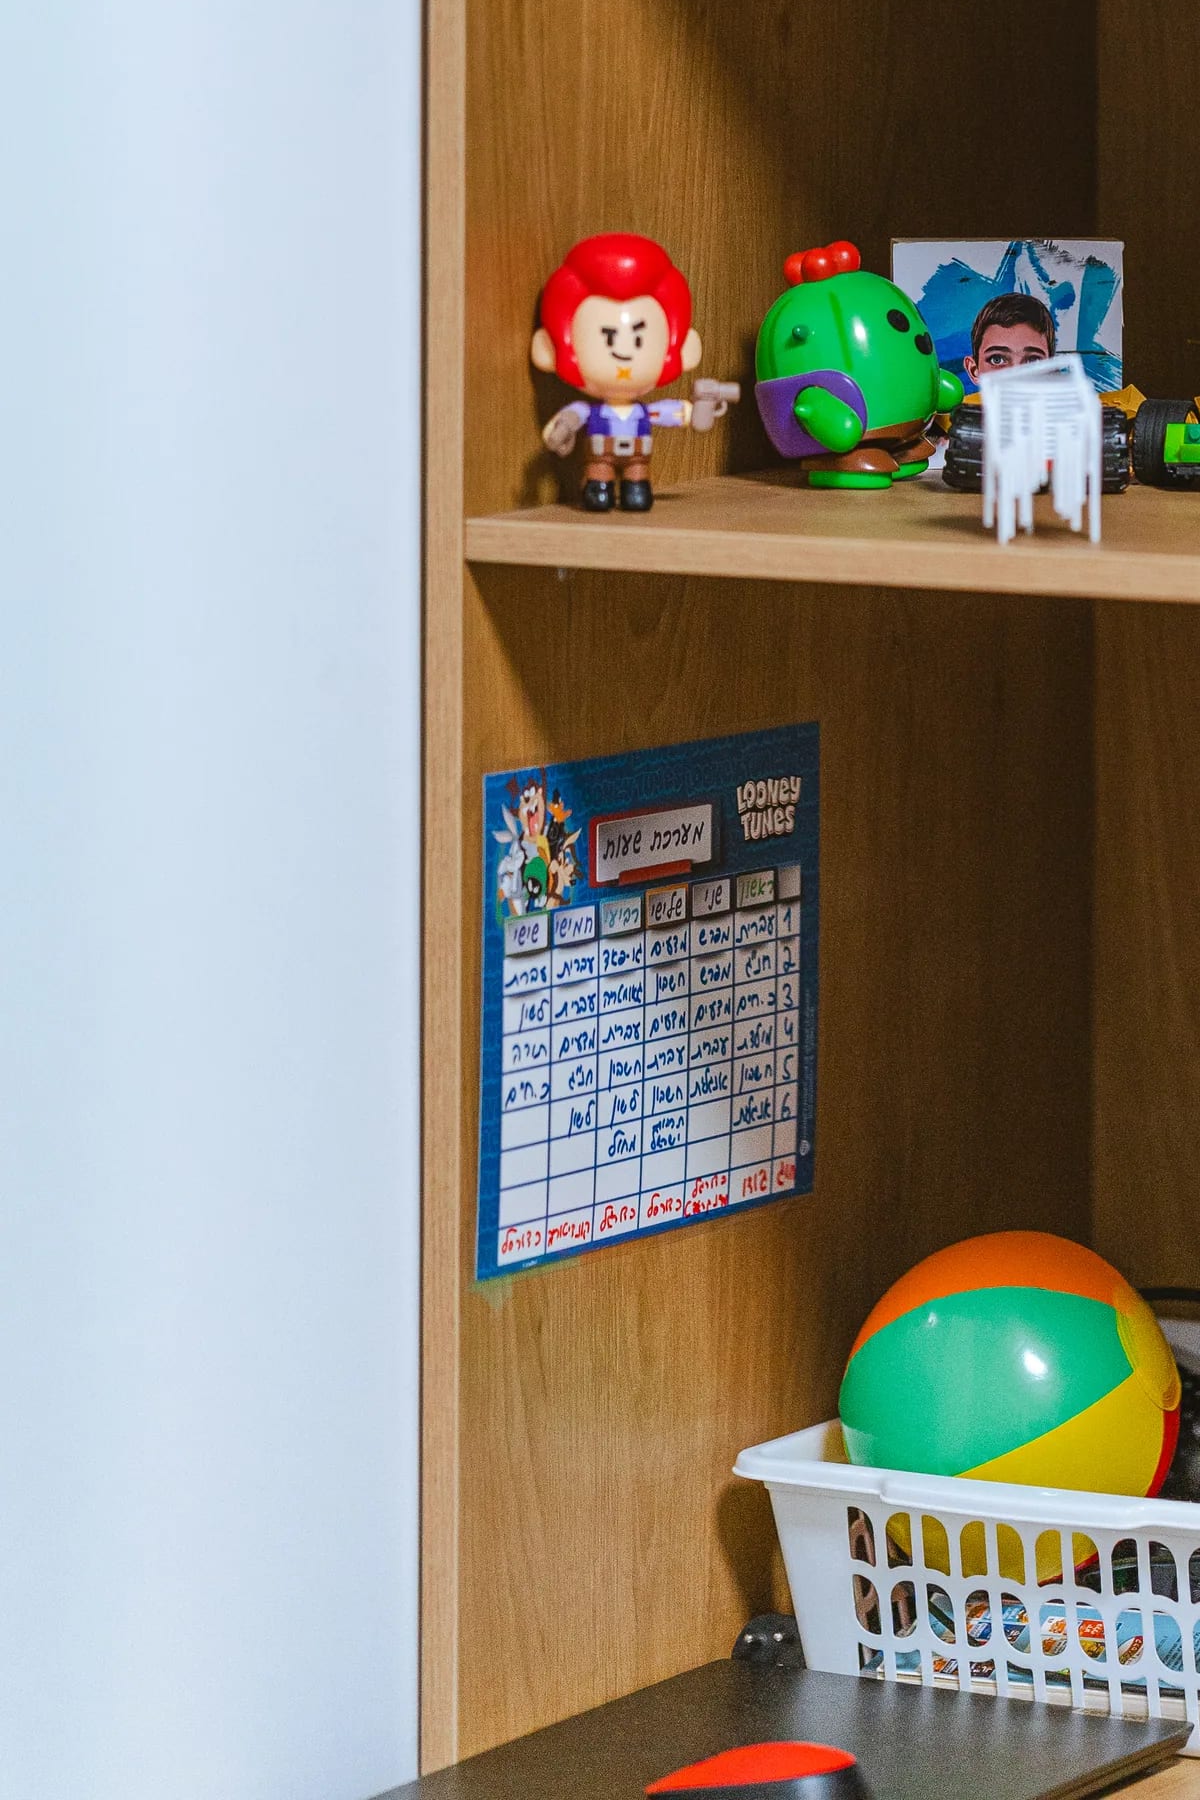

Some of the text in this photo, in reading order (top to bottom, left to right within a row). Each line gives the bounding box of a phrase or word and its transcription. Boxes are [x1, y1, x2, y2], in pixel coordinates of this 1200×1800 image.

[736, 775, 802, 814] LOONEY
[740, 805, 795, 841] TUNES
[602, 821, 705, 860] מערכת שעות
[651, 891, 683, 921] שלישי
[704, 884, 723, 910] שני
[739, 879, 775, 906] ראשון
[554, 916, 593, 938] חמישי
[604, 907, 639, 929] רביעי
[735, 914, 776, 944] עברית
[783, 906, 792, 932] 1
[513, 921, 540, 946] שישי
[650, 930, 687, 957] מדעים
[556, 956, 595, 979] עברית
[782, 946, 796, 973] 2
[655, 971, 686, 1005] חשבון
[782, 983, 793, 1009] 3
[518, 998, 550, 1033] לשון
[555, 992, 596, 1019] עברית
[694, 998, 731, 1027] מדעים
[602, 1021, 641, 1044] עברית
[649, 1010, 686, 1038] מדעים
[784, 1016, 794, 1042] 4
[512, 1043, 547, 1066] תורה
[558, 1028, 596, 1059] מדעים
[608, 1058, 642, 1093] חשבון
[739, 1063, 773, 1094] חשבון
[782, 1053, 794, 1080] 5
[609, 1088, 640, 1129] לשון
[651, 1084, 683, 1116] חשבון
[781, 1092, 792, 1119] 6
[567, 1099, 596, 1138] לשון
[608, 1129, 637, 1157] מחול
[647, 1192, 683, 1218] כדורסל
[501, 1227, 542, 1255] כדורסל
